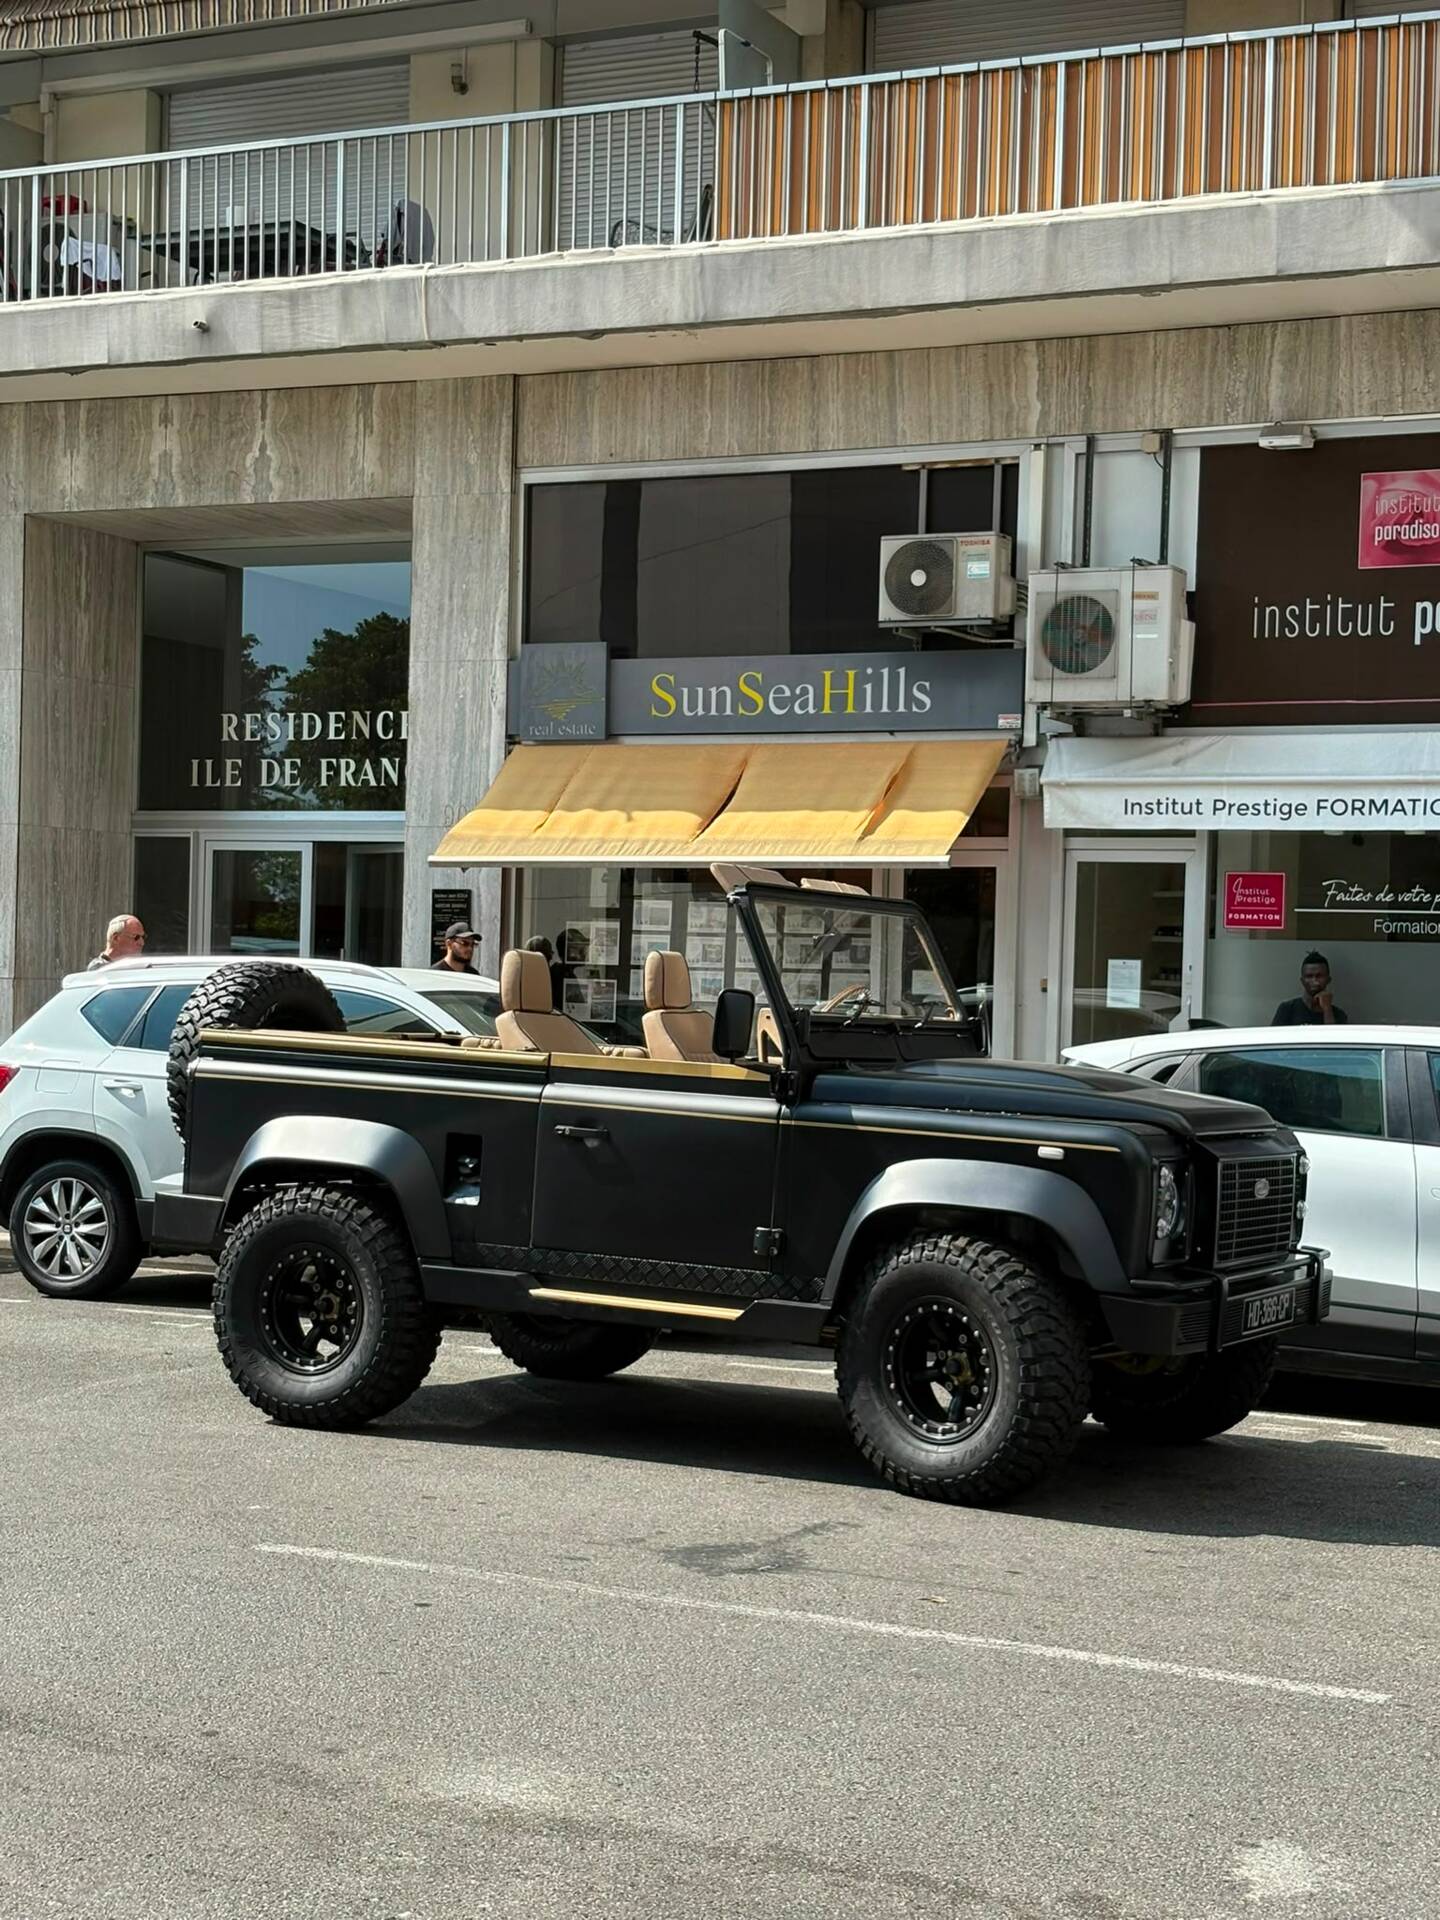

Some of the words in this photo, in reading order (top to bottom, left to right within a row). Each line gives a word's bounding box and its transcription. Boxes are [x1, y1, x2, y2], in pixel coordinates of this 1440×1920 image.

[1375, 494, 1440, 515] institut
[1374, 519, 1439, 546] paradiso
[1253, 594, 1396, 639] institut
[1414, 600, 1440, 646] p
[651, 667, 932, 717] SunSeaHills
[529, 721, 554, 736] real
[558, 723, 597, 736] estate
[190, 759, 243, 787] ILE
[260, 758, 301, 786] DE
[320, 757, 409, 787] FRAN
[1123, 797, 1204, 816] Institut
[1212, 798, 1308, 821] Prestige
[1237, 895, 1276, 905] Prestige
[1322, 879, 1373, 908] Faites
[1375, 883, 1396, 902] de
[1398, 884, 1432, 902] votre
[1228, 912, 1280, 920] FORMATION
[1373, 919, 1440, 934] Formatio
